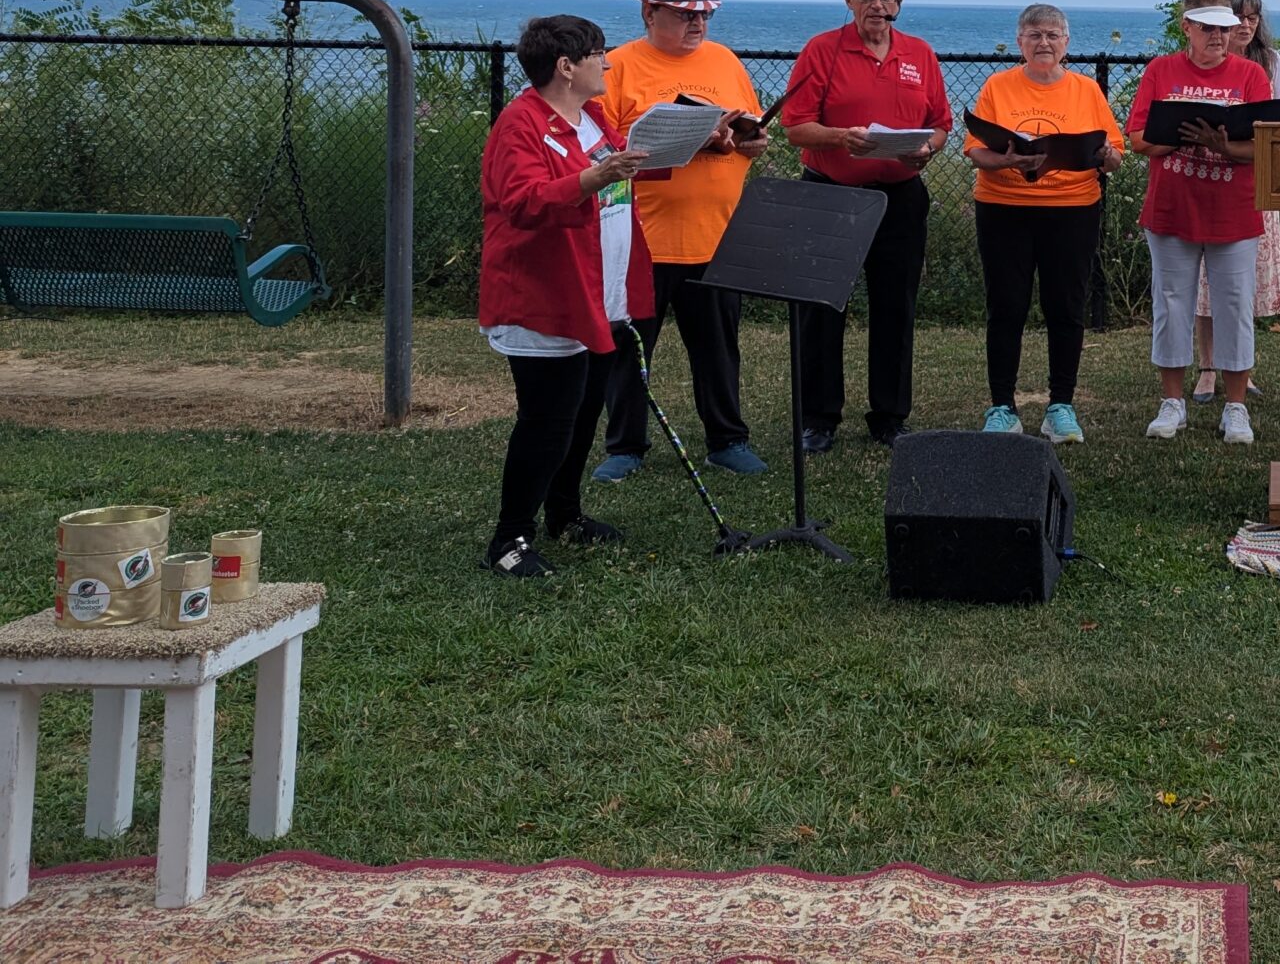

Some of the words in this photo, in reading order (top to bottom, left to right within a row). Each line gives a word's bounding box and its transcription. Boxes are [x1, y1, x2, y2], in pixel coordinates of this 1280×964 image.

[899, 67, 921, 79] Family
[657, 82, 720, 99] Saybrook
[1182, 85, 1232, 98] HAPPY
[1010, 107, 1068, 124] Saybrook
[705, 156, 735, 165] Church
